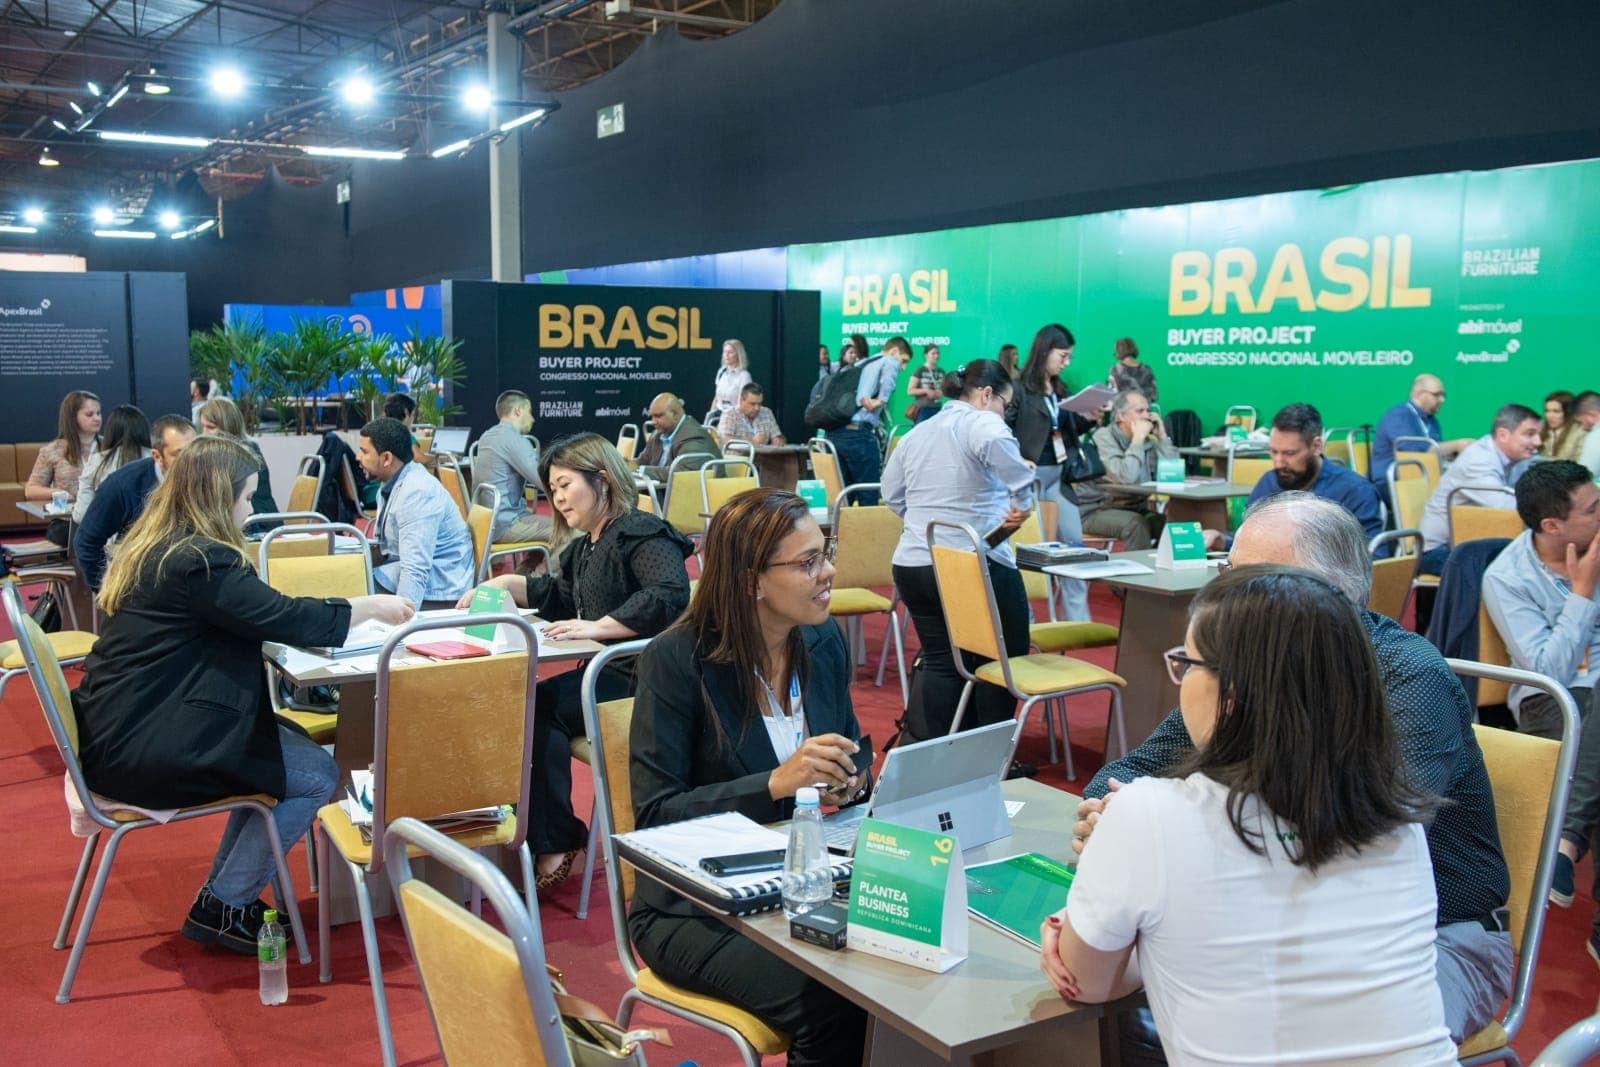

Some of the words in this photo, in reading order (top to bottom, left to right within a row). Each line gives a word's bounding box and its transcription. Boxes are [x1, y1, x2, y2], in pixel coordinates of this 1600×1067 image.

[1463, 247, 1540, 262] BRAZILIAN
[1168, 234, 1432, 316] BRASIL
[1462, 261, 1539, 277] FURNITURE
[842, 269, 957, 316] BRASIL
[539, 304, 712, 349] BRASIL
[842, 322, 869, 334] BUYER
[870, 321, 909, 333] PROJECT
[1168, 328, 1225, 346] BUYER
[1228, 325, 1316, 345] PROJECT
[539, 357, 582, 368] BUYER
[585, 357, 642, 369] PROJECT
[1168, 351, 1247, 366] CONGRESSO
[1250, 351, 1320, 365] NACIONAL
[1323, 350, 1413, 365] MOVELEIRO
[540, 372, 588, 381] CONGRESSO
[590, 372, 628, 380] NACIONAL
[629, 372, 671, 380] MOVELEIRO
[540, 401, 583, 409] BRAZILIAN
[540, 408, 583, 417] FURNITURE
[595, 407, 630, 416] abimóvel
[859, 881, 908, 904] PLANTEA
[858, 895, 910, 918] BUSINESS
